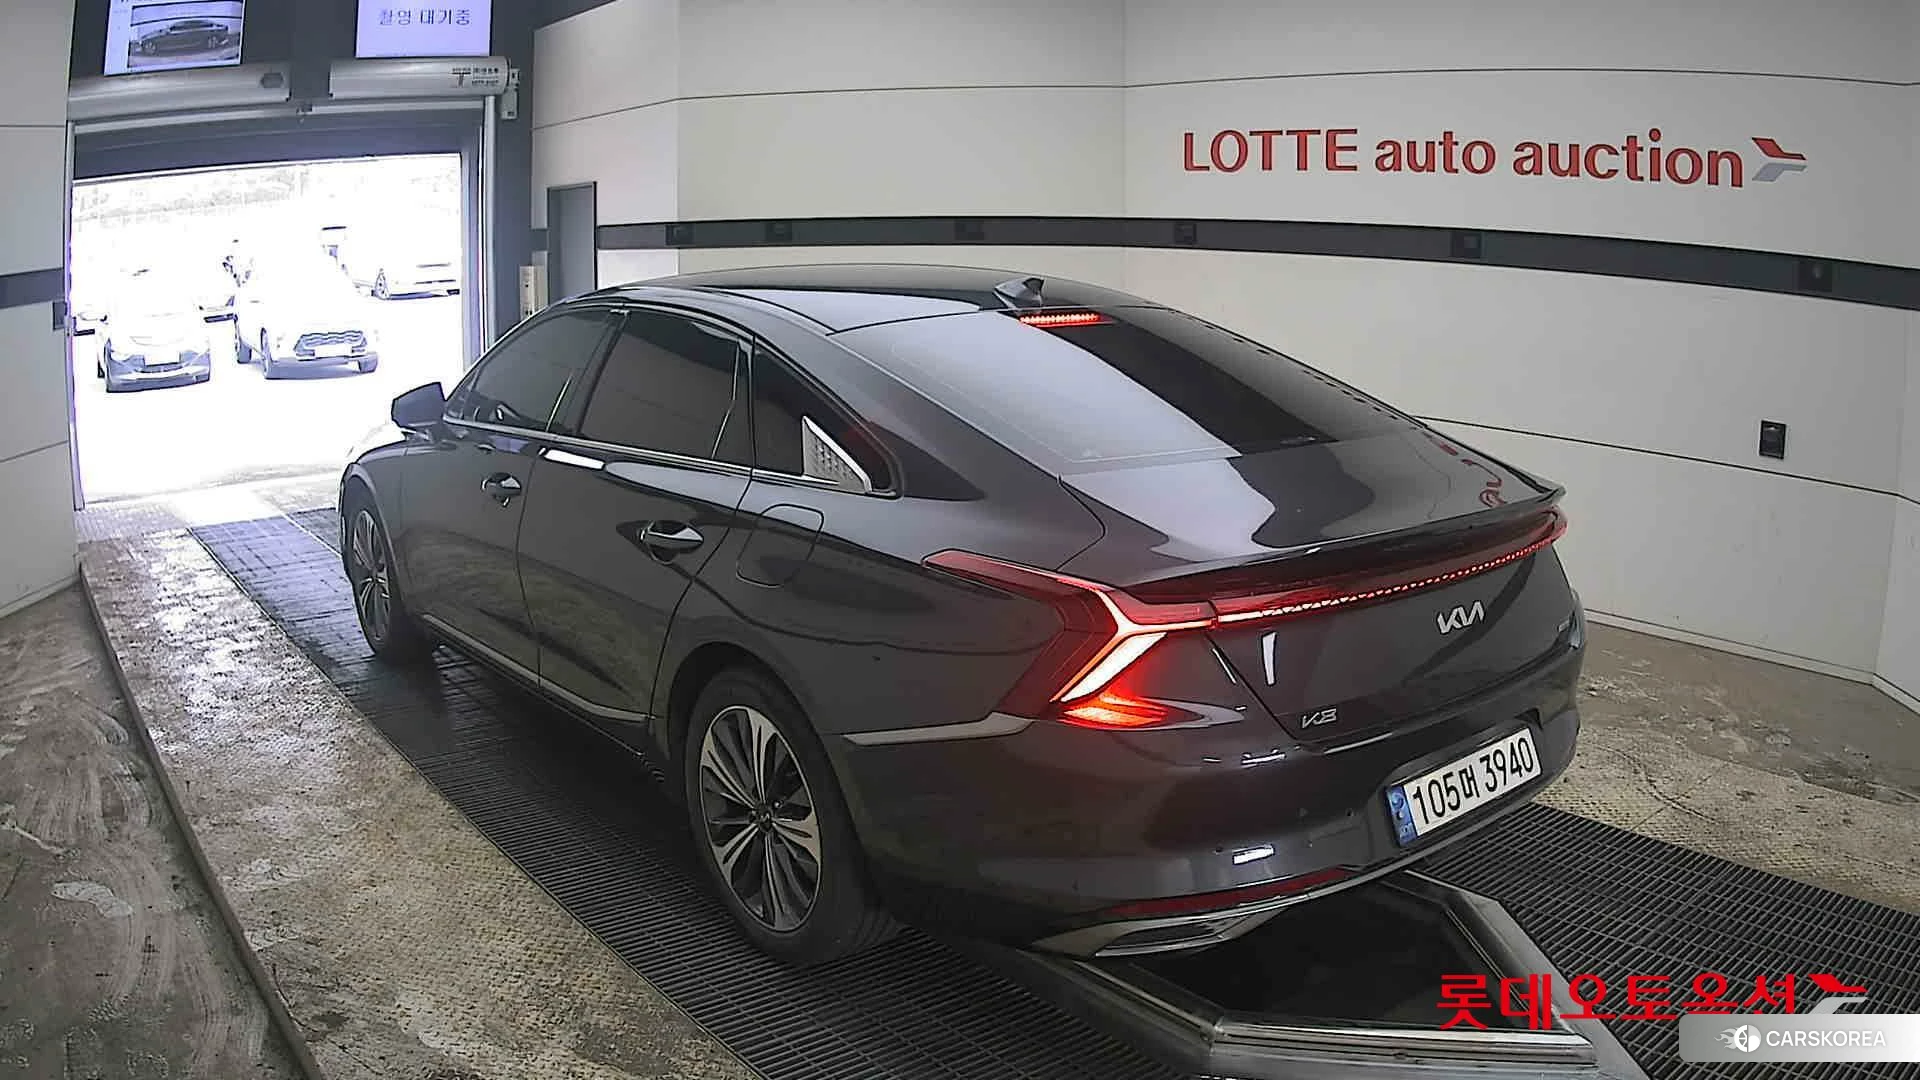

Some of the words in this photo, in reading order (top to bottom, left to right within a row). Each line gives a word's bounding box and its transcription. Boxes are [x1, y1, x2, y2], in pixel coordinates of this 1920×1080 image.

[420, 8, 470, 26] 대기중
[1183, 128, 1358, 174] LOTTE
[1374, 130, 1497, 175] auto
[1512, 127, 1744, 188] auction
[1301, 708, 1338, 730] K8
[1412, 764, 1481, 825] 105머
[1479, 737, 1535, 793] 3940
